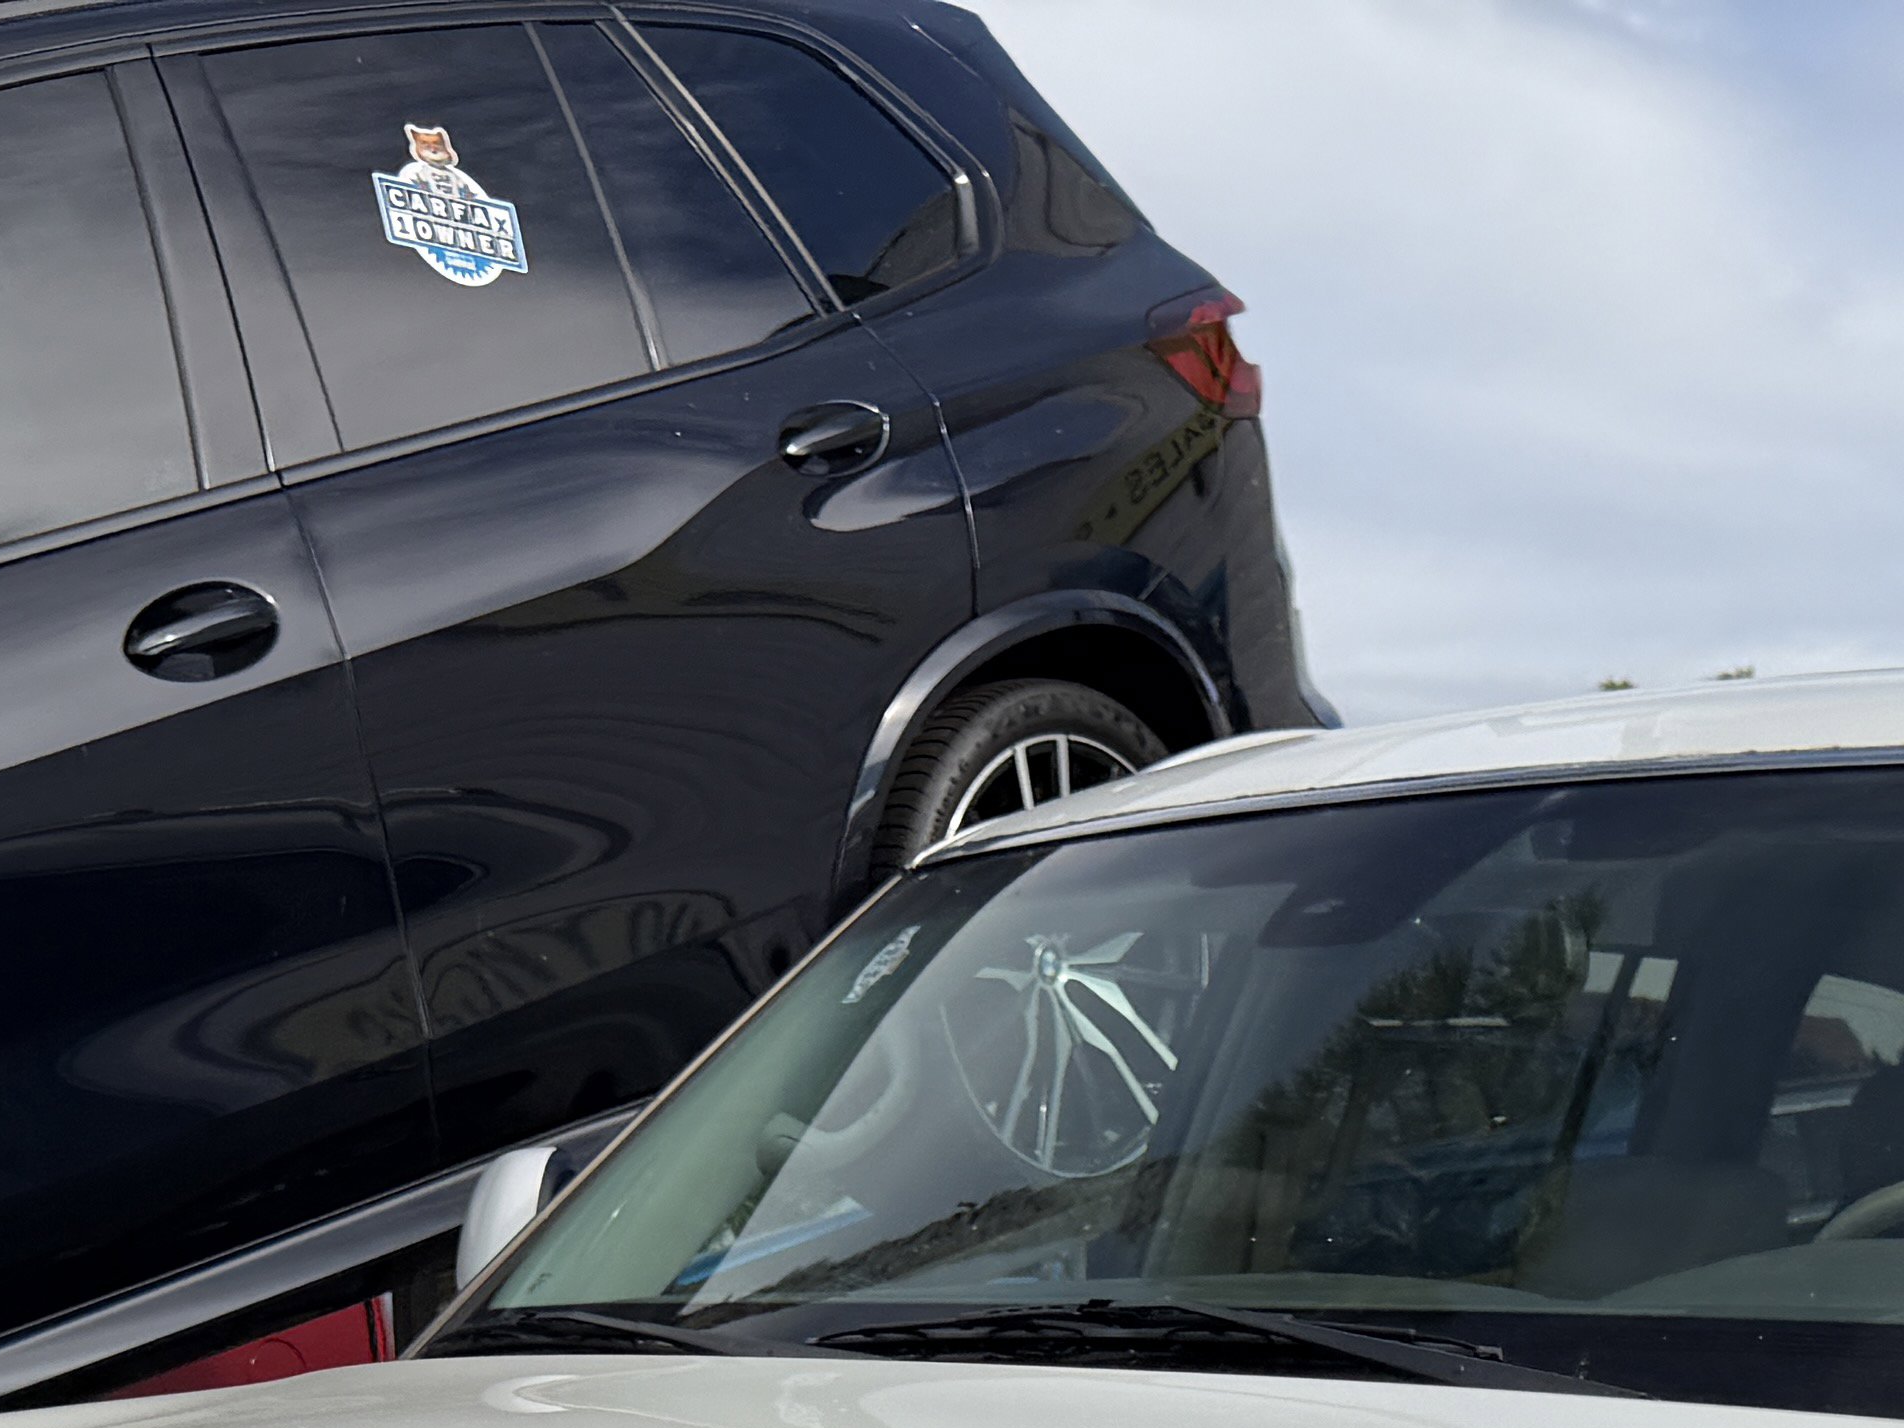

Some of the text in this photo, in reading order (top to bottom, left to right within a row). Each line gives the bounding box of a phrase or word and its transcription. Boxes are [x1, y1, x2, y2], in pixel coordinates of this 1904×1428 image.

[388, 188, 509, 236] CARFAX
[397, 216, 410, 234] 1
[415, 220, 516, 260] OWNER
